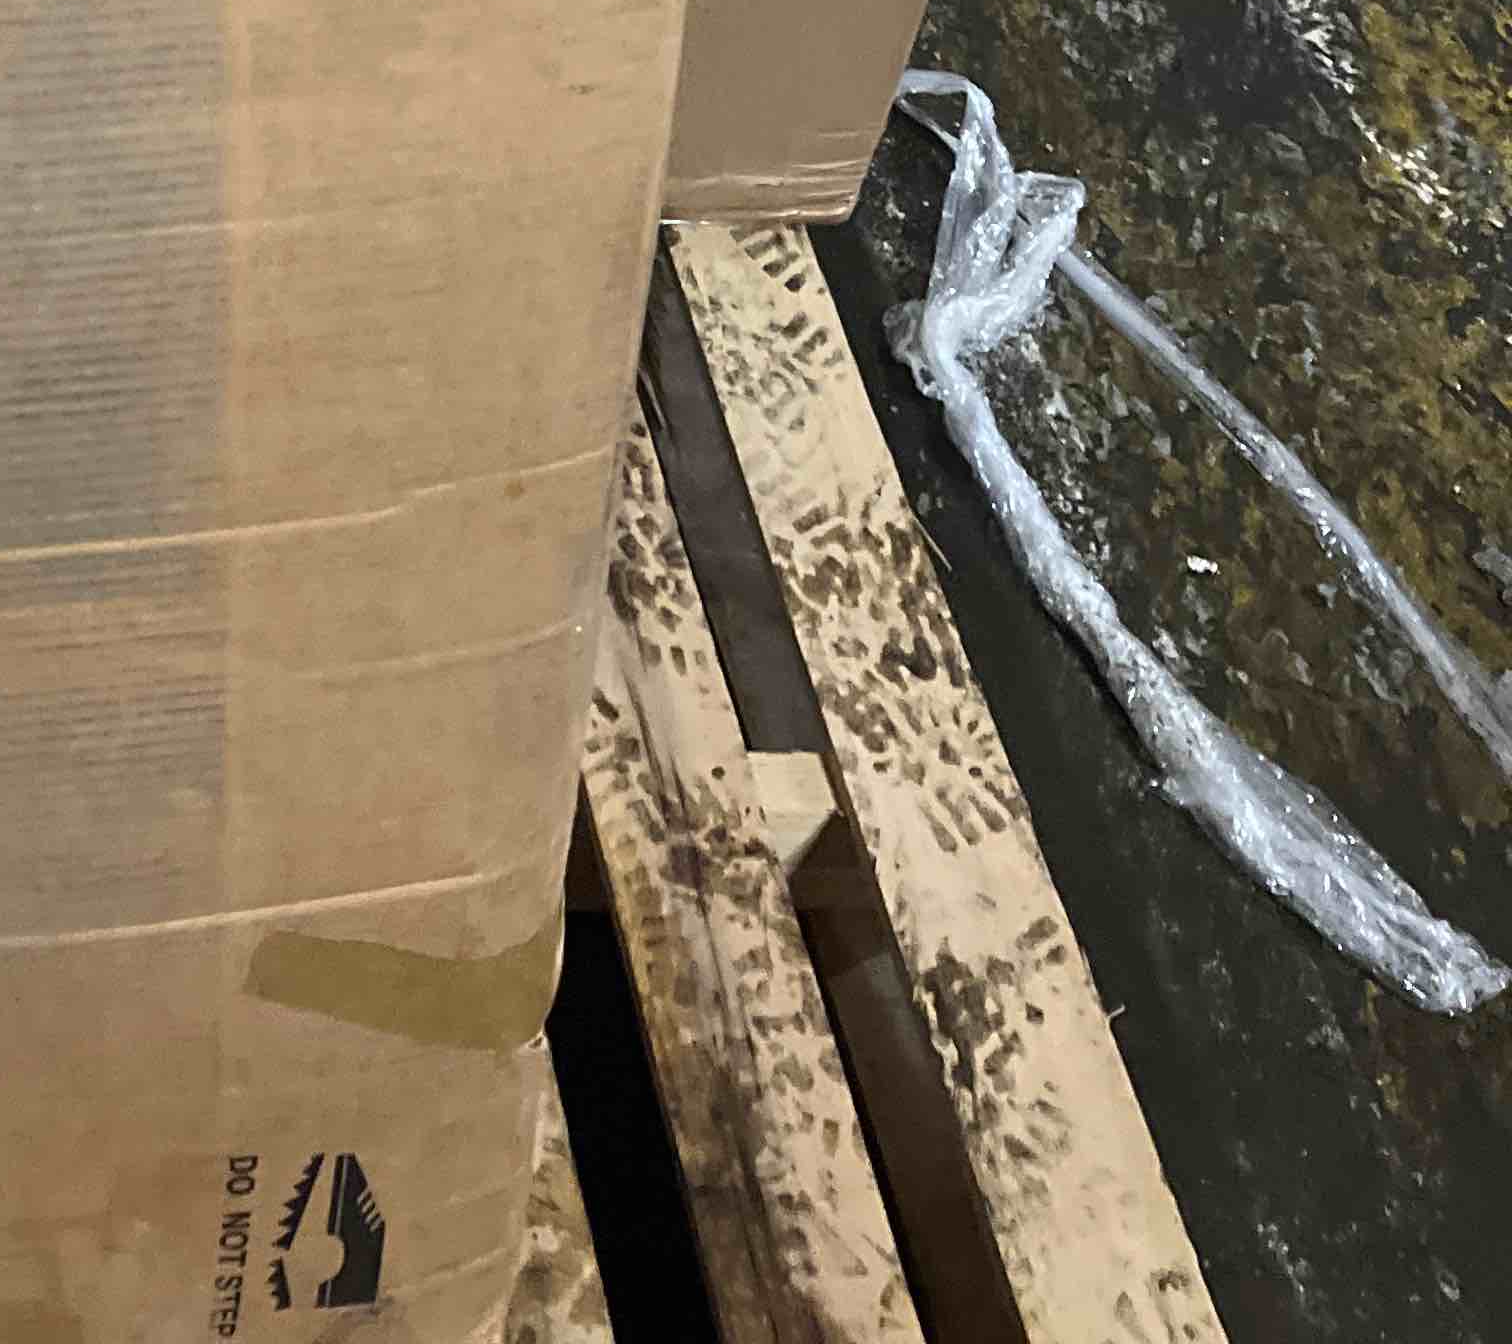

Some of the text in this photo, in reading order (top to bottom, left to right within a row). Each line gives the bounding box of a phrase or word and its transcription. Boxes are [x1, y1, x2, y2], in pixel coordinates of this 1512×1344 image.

[210, 1155, 259, 1338] DO NOT STEP
